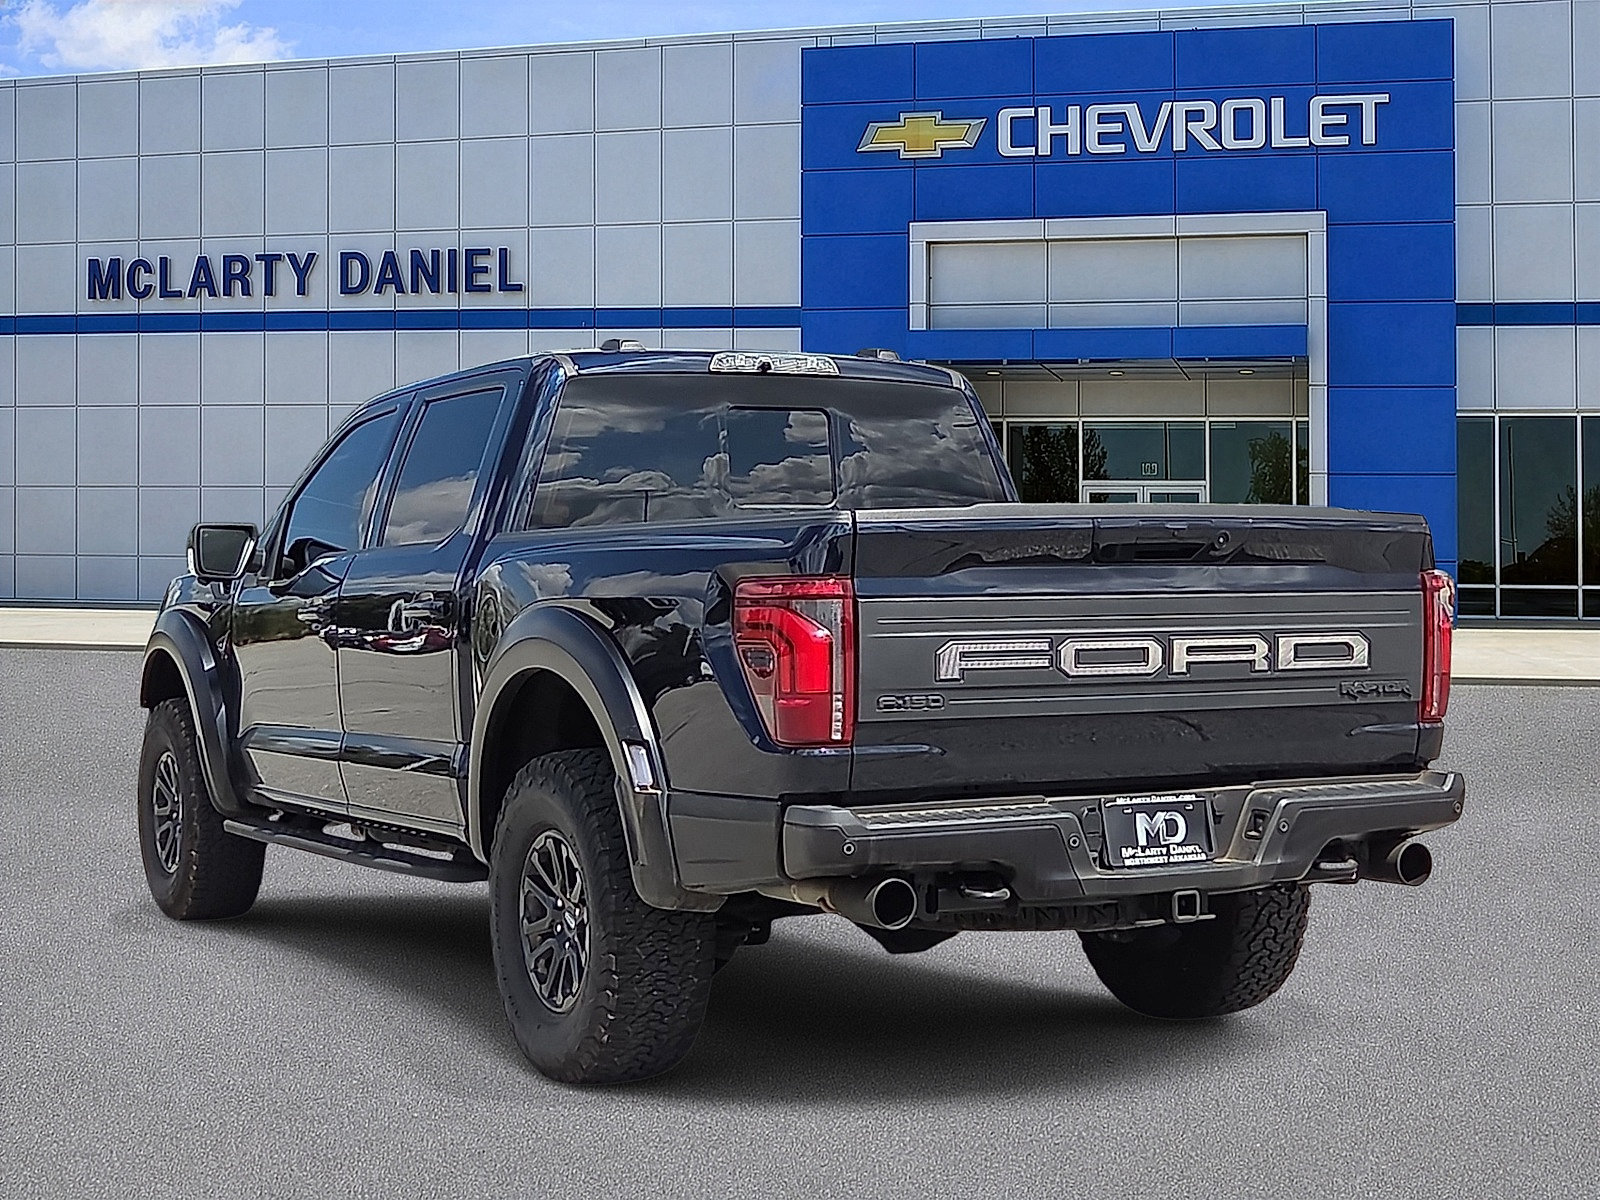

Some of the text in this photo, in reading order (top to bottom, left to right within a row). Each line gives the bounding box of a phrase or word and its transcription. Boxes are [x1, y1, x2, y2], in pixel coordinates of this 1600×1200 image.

[997, 93, 1390, 158] CHEVROLET
[87, 246, 526, 300] MCLARTY DANIEL
[936, 633, 1370, 681] FORD
[1135, 811, 1186, 846] MD
